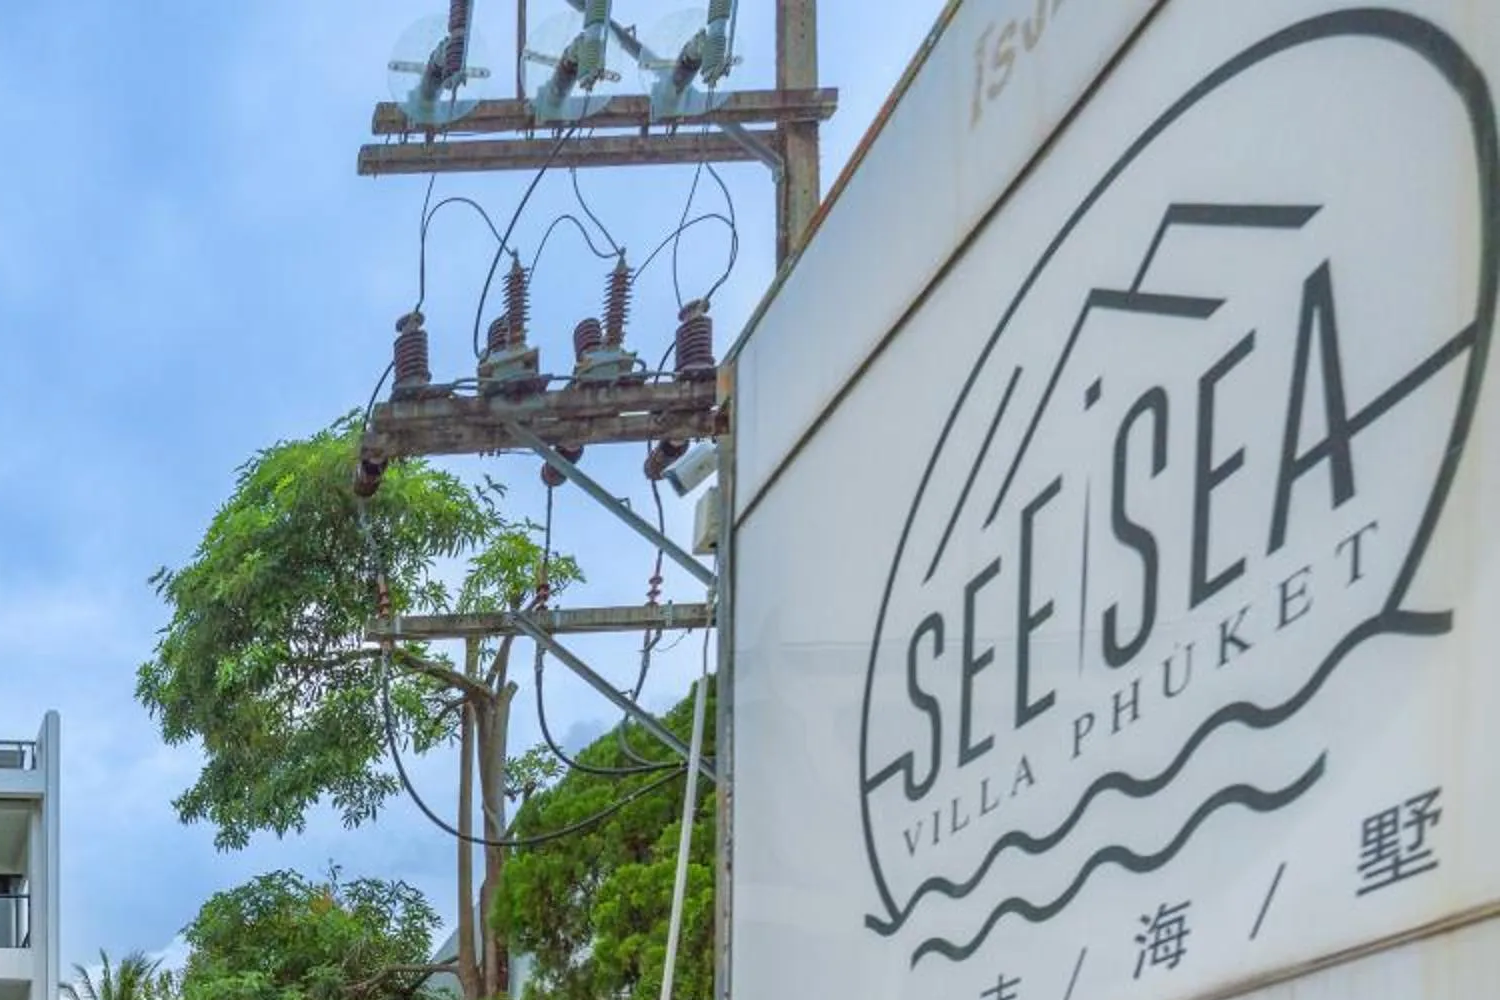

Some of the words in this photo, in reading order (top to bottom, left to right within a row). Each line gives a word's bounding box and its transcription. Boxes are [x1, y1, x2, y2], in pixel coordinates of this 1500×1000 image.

[902, 475, 1062, 801] SEE
[1101, 257, 1357, 669] SEA
[902, 755, 1037, 858] VILLA
[1070, 521, 1379, 758] PHUKET
